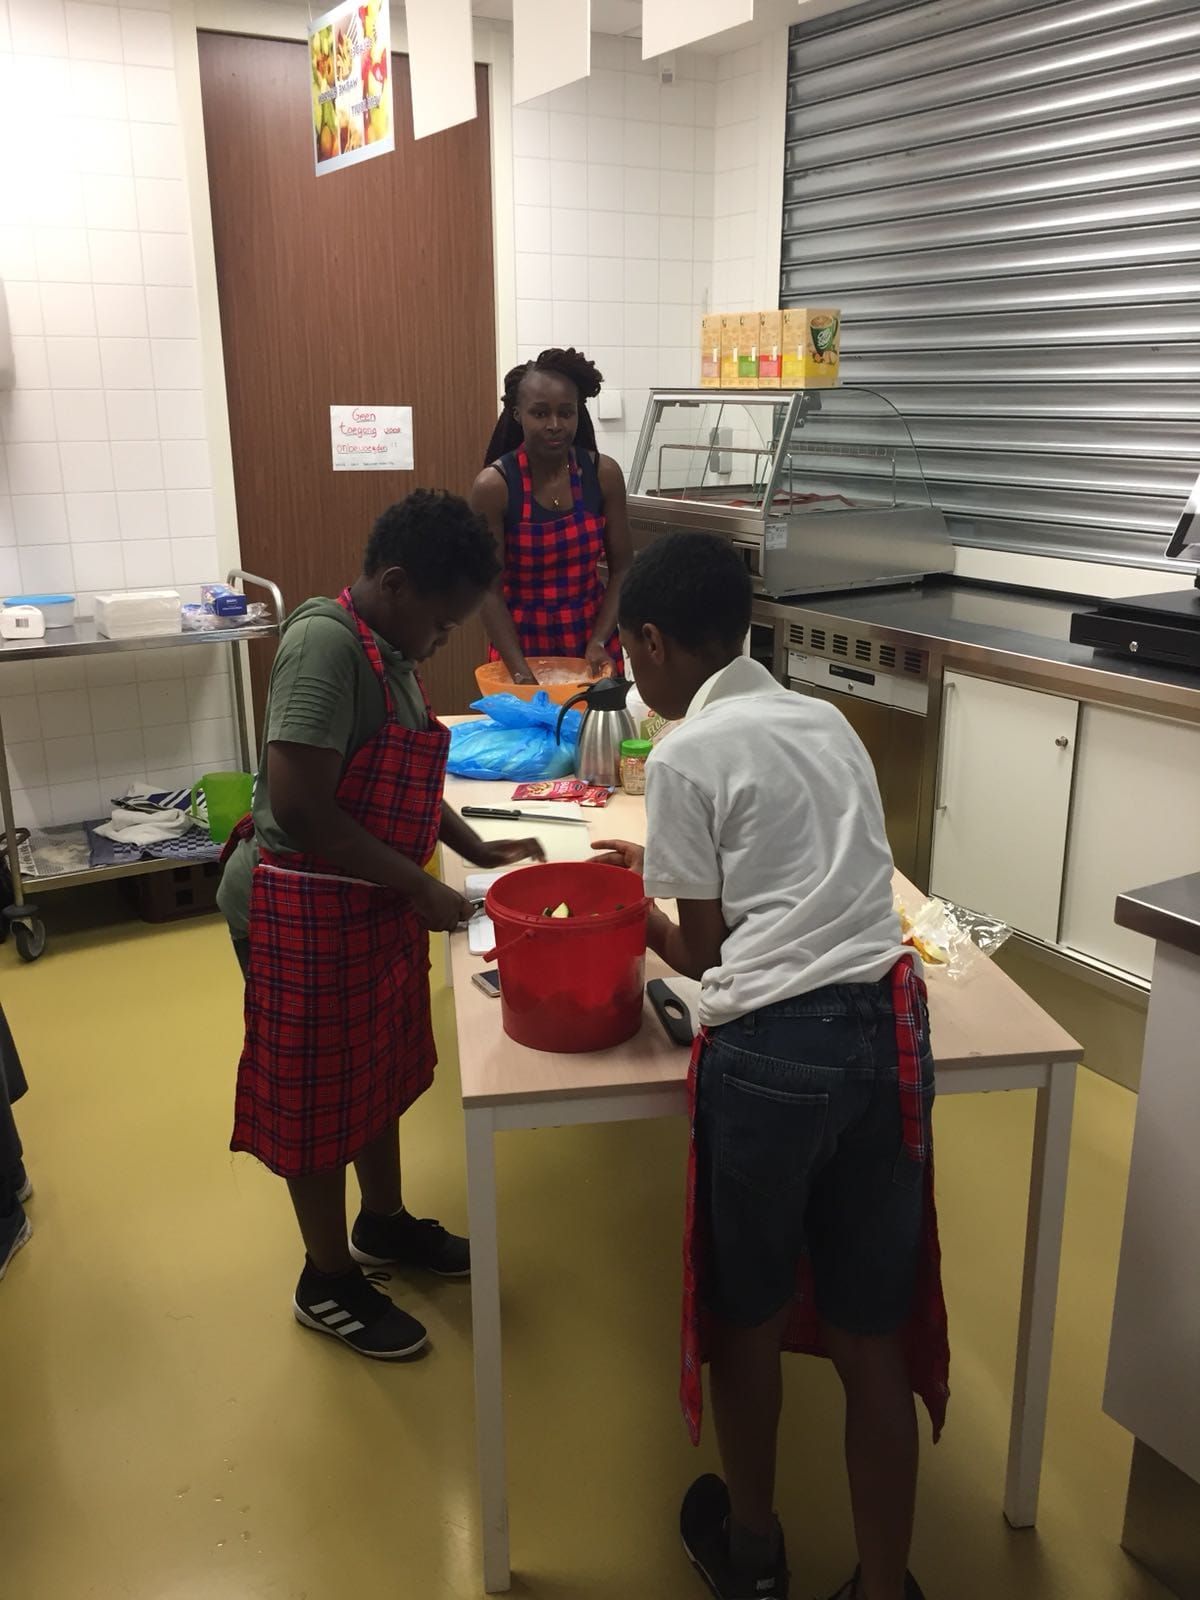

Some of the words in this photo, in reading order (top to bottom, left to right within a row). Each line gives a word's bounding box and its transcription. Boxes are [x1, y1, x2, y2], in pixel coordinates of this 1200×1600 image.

[352, 408, 376, 422] Geen
[339, 422, 377, 438] toegang
[647, 715, 667, 737] FLOU
